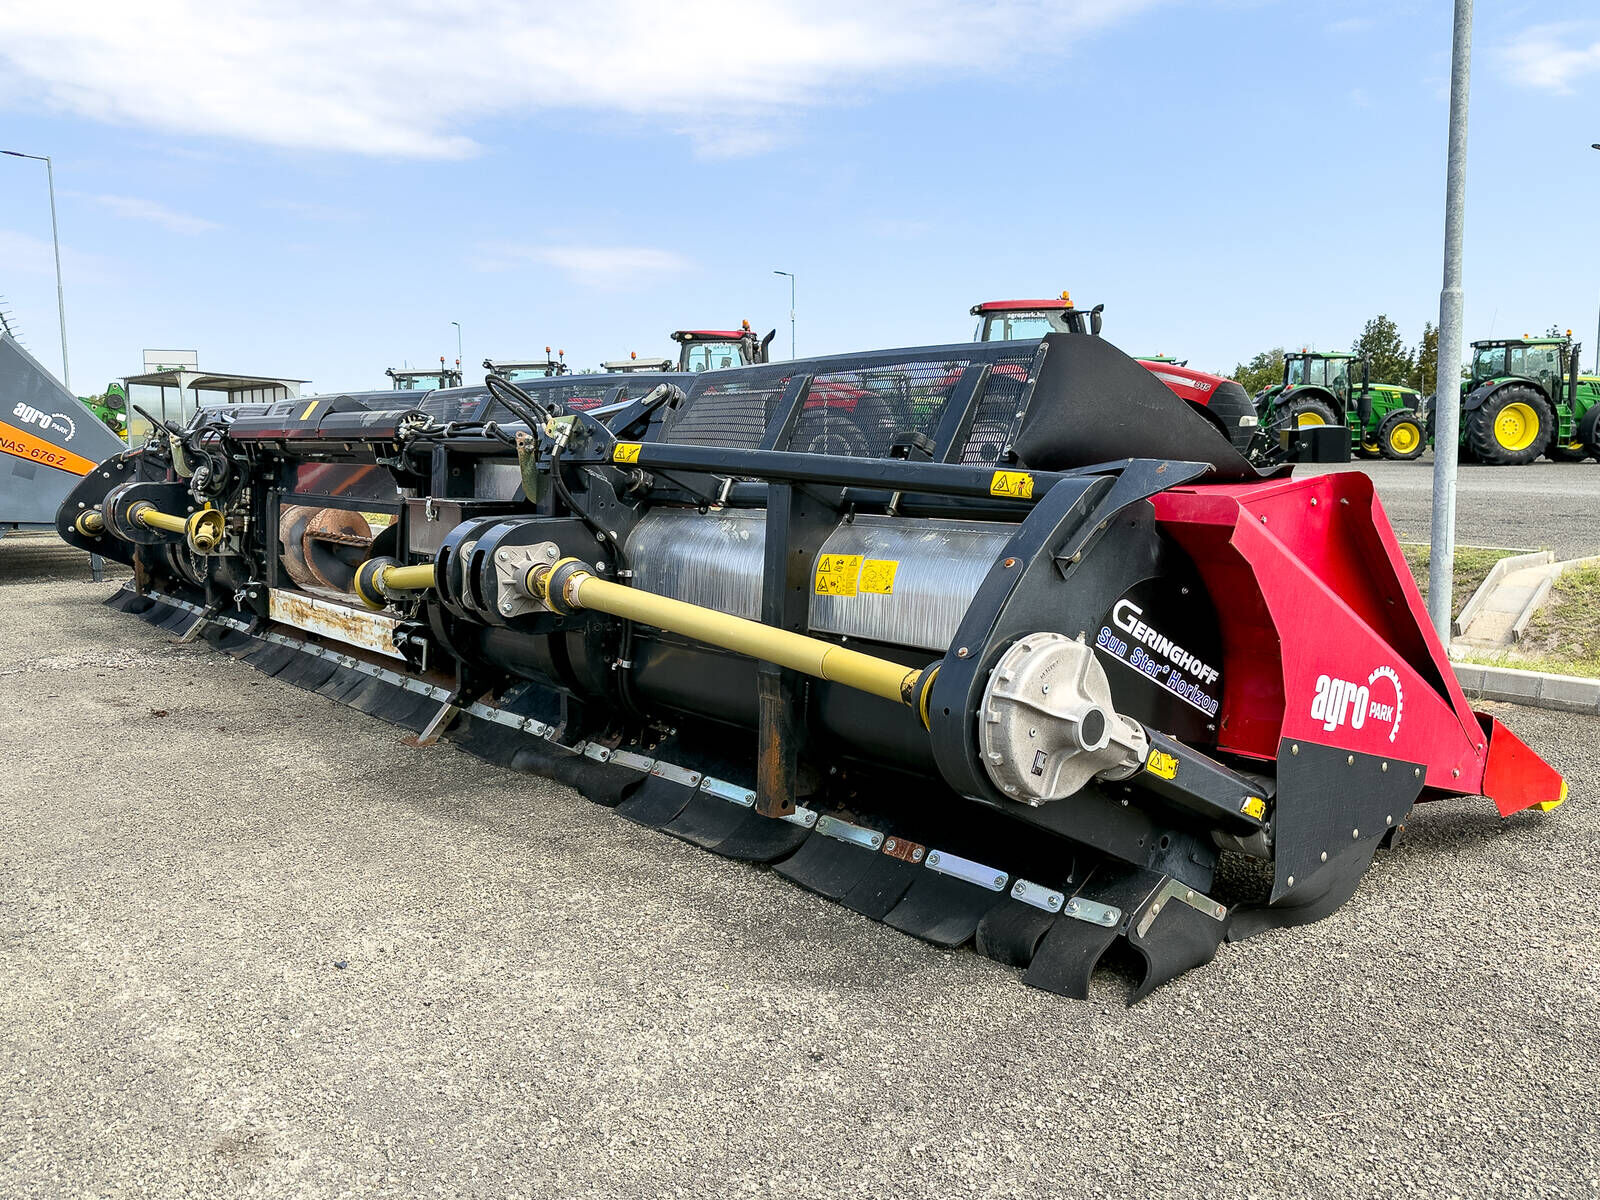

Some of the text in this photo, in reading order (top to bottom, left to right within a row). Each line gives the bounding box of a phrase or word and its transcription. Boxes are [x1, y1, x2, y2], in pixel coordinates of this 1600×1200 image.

[12, 402, 69, 435] agro PARK
[1097, 625, 1128, 657] Sun
[1166, 669, 1219, 715] Horizon
[1112, 598, 1220, 685] GERINGHOFF
[1310, 674, 1394, 732] agro PARK
